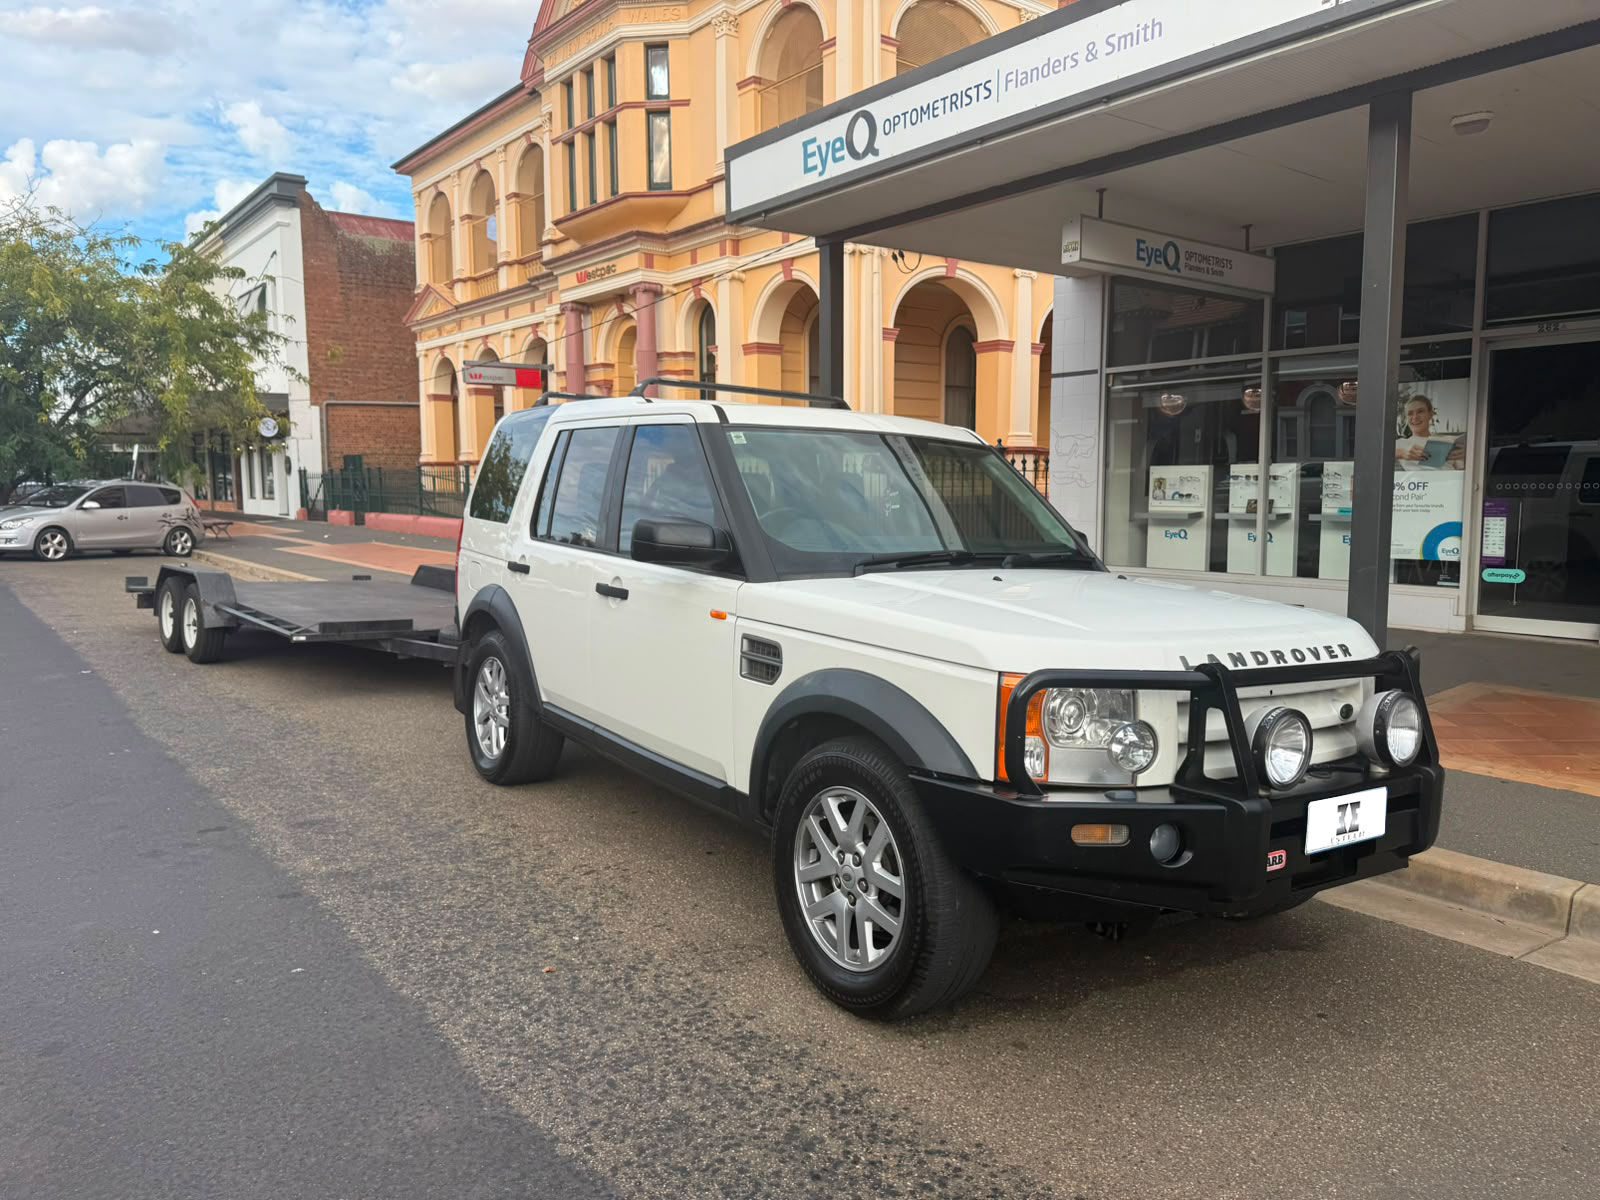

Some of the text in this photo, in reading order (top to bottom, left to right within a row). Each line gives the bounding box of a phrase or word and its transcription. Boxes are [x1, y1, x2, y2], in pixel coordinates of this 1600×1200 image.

[630, 7, 681, 23] WALES
[802, 18, 1163, 177] EyeQ OPTOMETRISTS Flanders & Smith
[1136, 238, 1233, 273] EyeQ OPTOMETRISTS
[576, 263, 617, 284] Westpac
[1184, 262, 1205, 274] Flanders
[1211, 267, 1225, 277] Smith
[469, 373, 504, 382] Westpac
[1408, 481, 1429, 491] OFF
[1164, 529, 1188, 540] EyeQ
[1441, 547, 1460, 555] EyeQ
